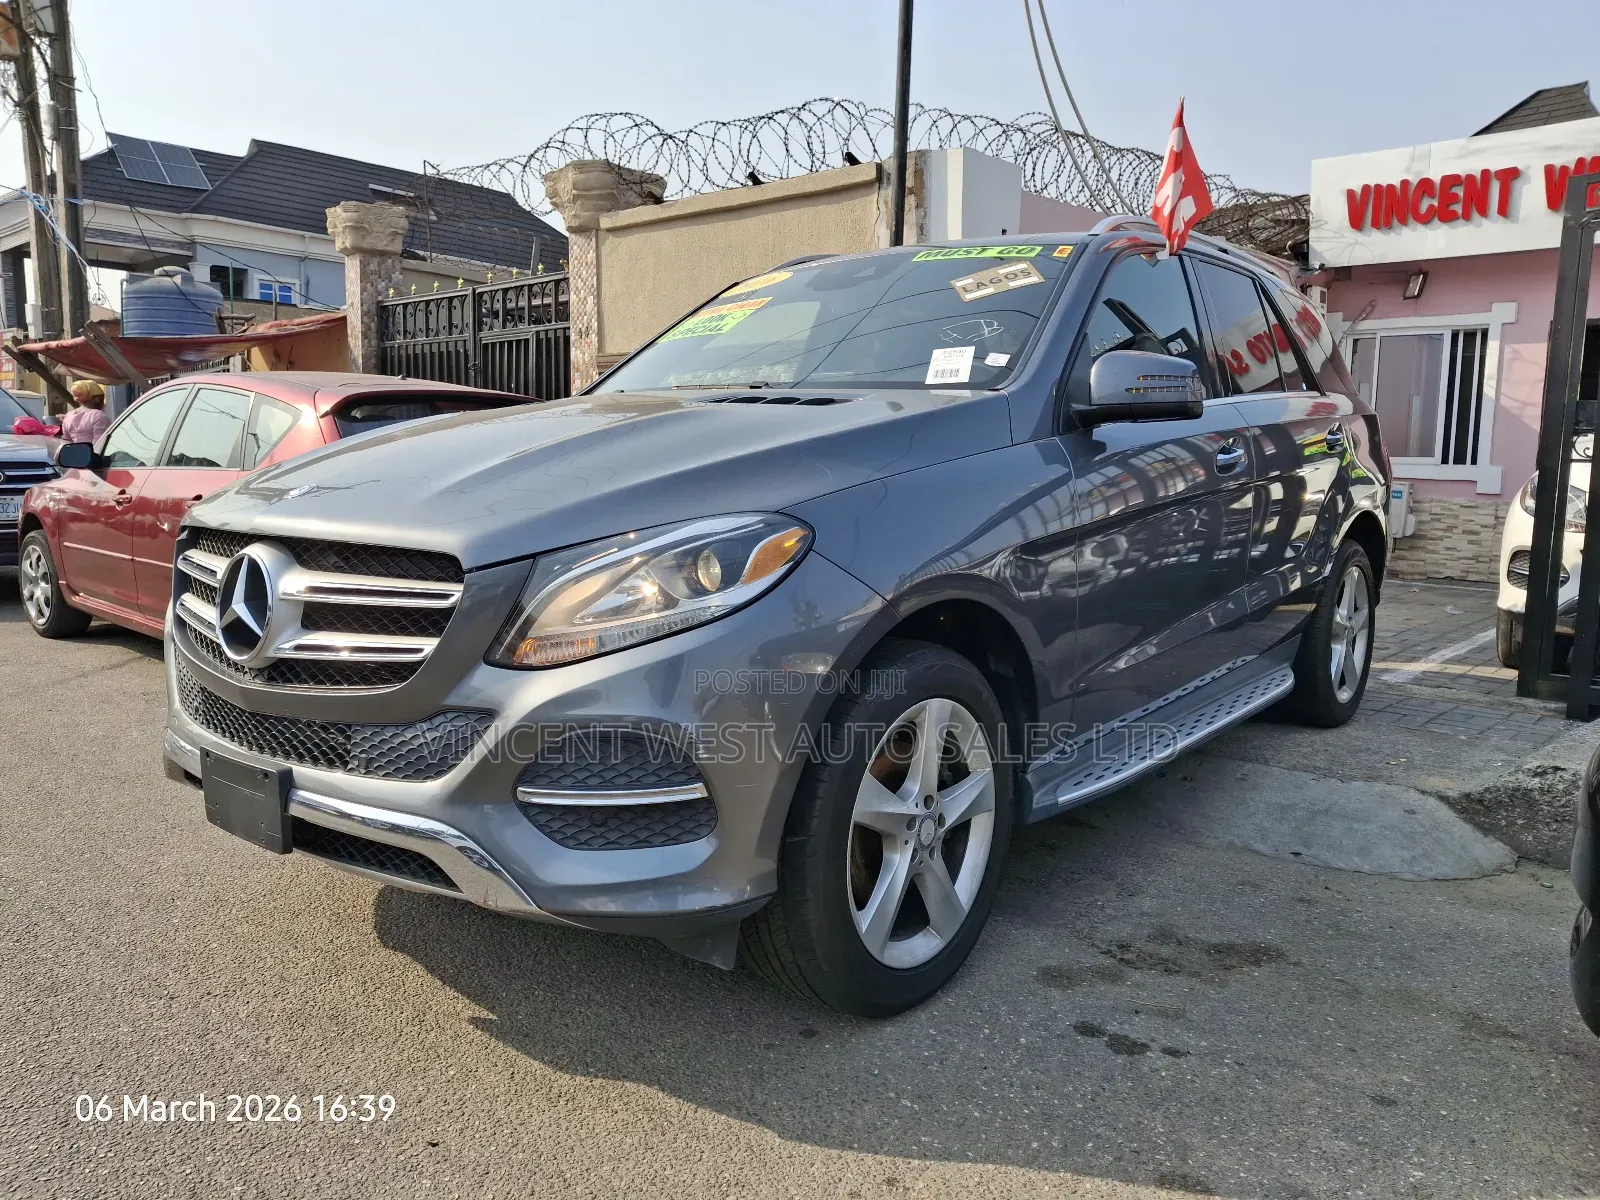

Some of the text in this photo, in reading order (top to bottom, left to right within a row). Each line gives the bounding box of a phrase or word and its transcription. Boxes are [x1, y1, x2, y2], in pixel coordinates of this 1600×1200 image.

[1346, 166, 1520, 231] VINCENT
[996, 246, 1037, 256] GO
[962, 269, 1033, 293] LAGOS
